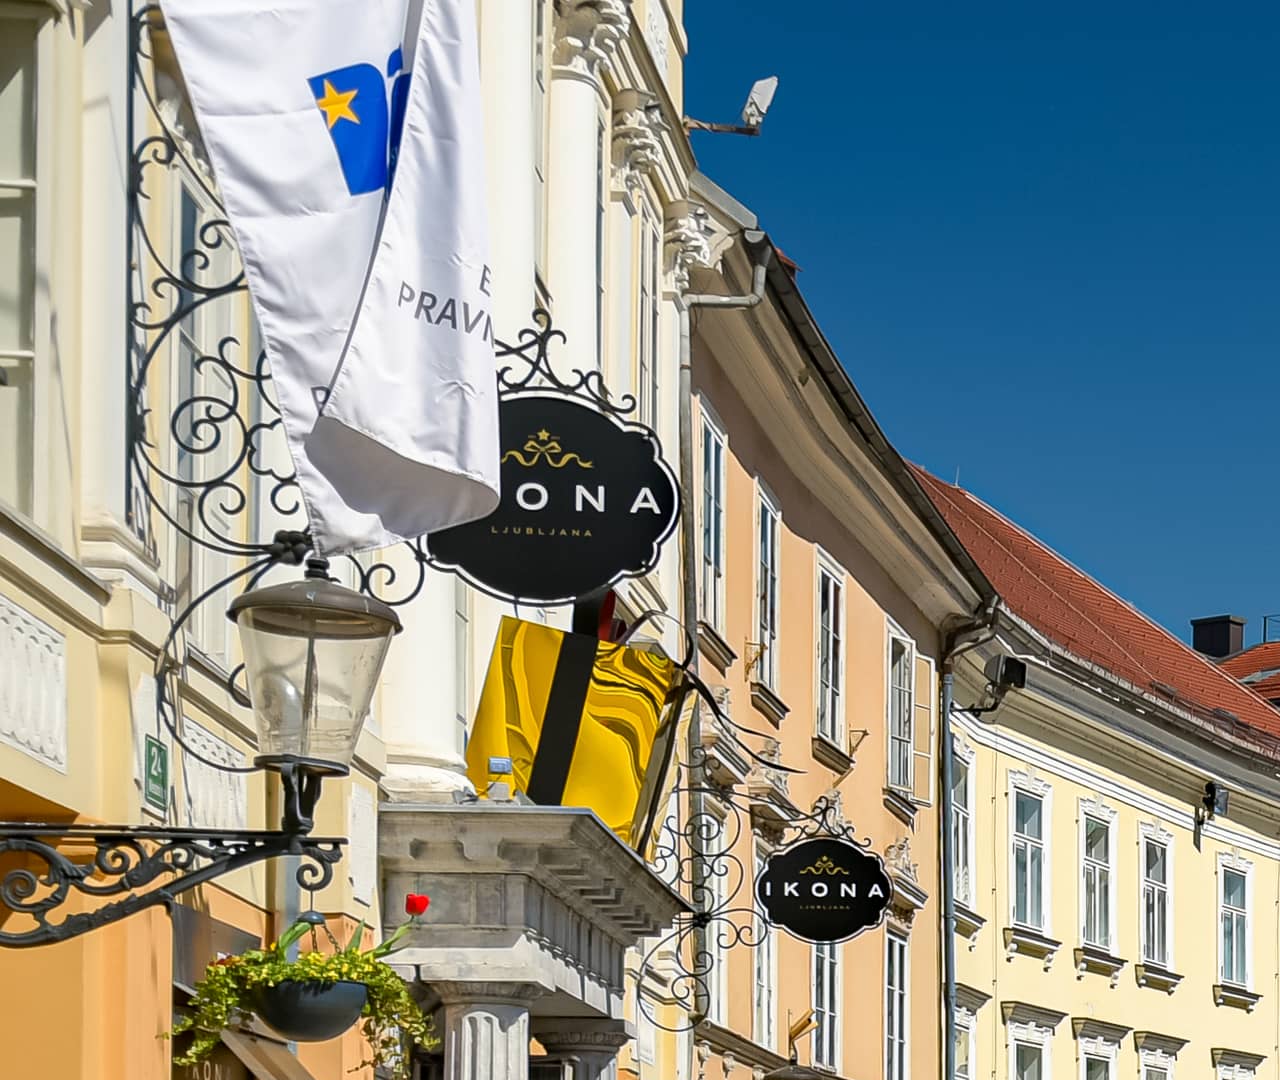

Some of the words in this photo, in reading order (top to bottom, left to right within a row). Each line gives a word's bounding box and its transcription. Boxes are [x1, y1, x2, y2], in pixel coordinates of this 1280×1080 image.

[516, 482, 662, 515] ONA
[491, 525, 593, 538] LJUBLJANA
[765, 881, 884, 898] IKONA
